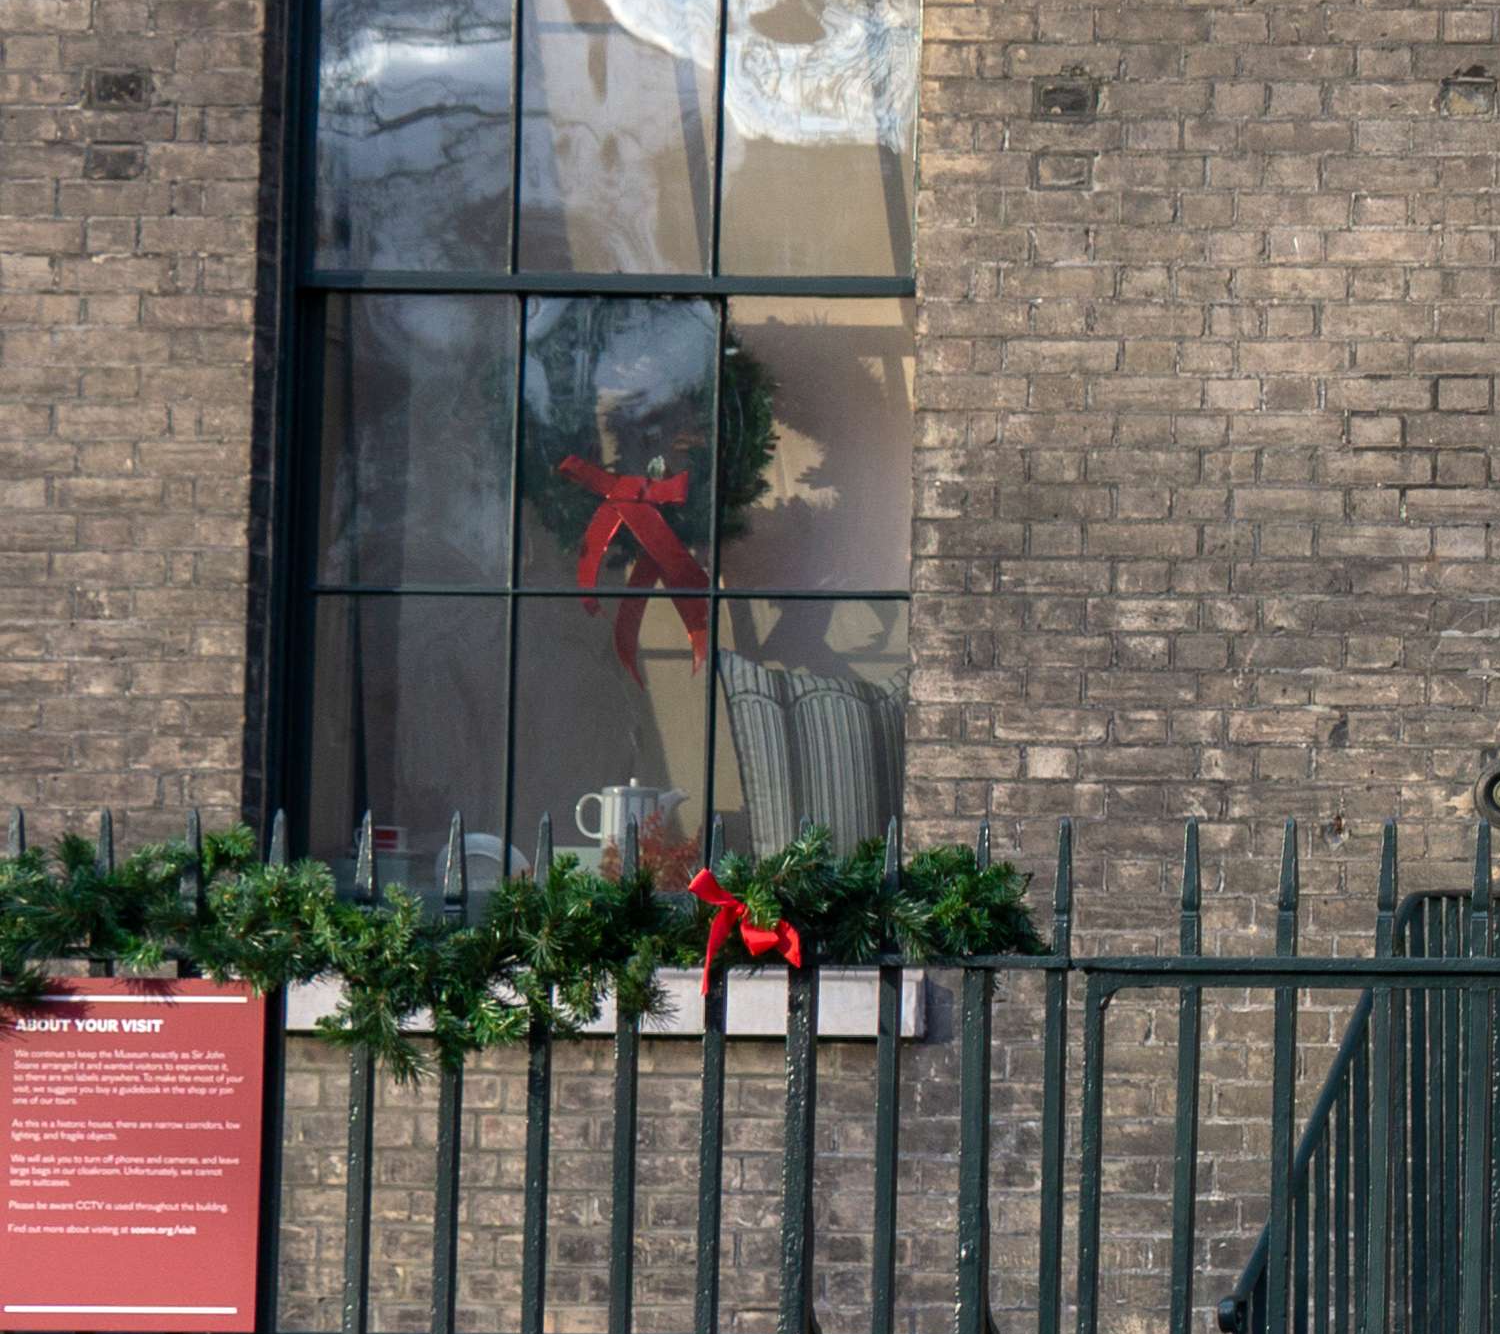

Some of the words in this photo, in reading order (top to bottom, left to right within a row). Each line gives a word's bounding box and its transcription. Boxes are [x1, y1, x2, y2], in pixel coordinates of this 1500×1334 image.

[16, 1019, 71, 1032] ABOUT
[75, 1019, 118, 1032] YOUR
[121, 1019, 164, 1032] VISIT
[75, 1200, 104, 1210] CCTV
